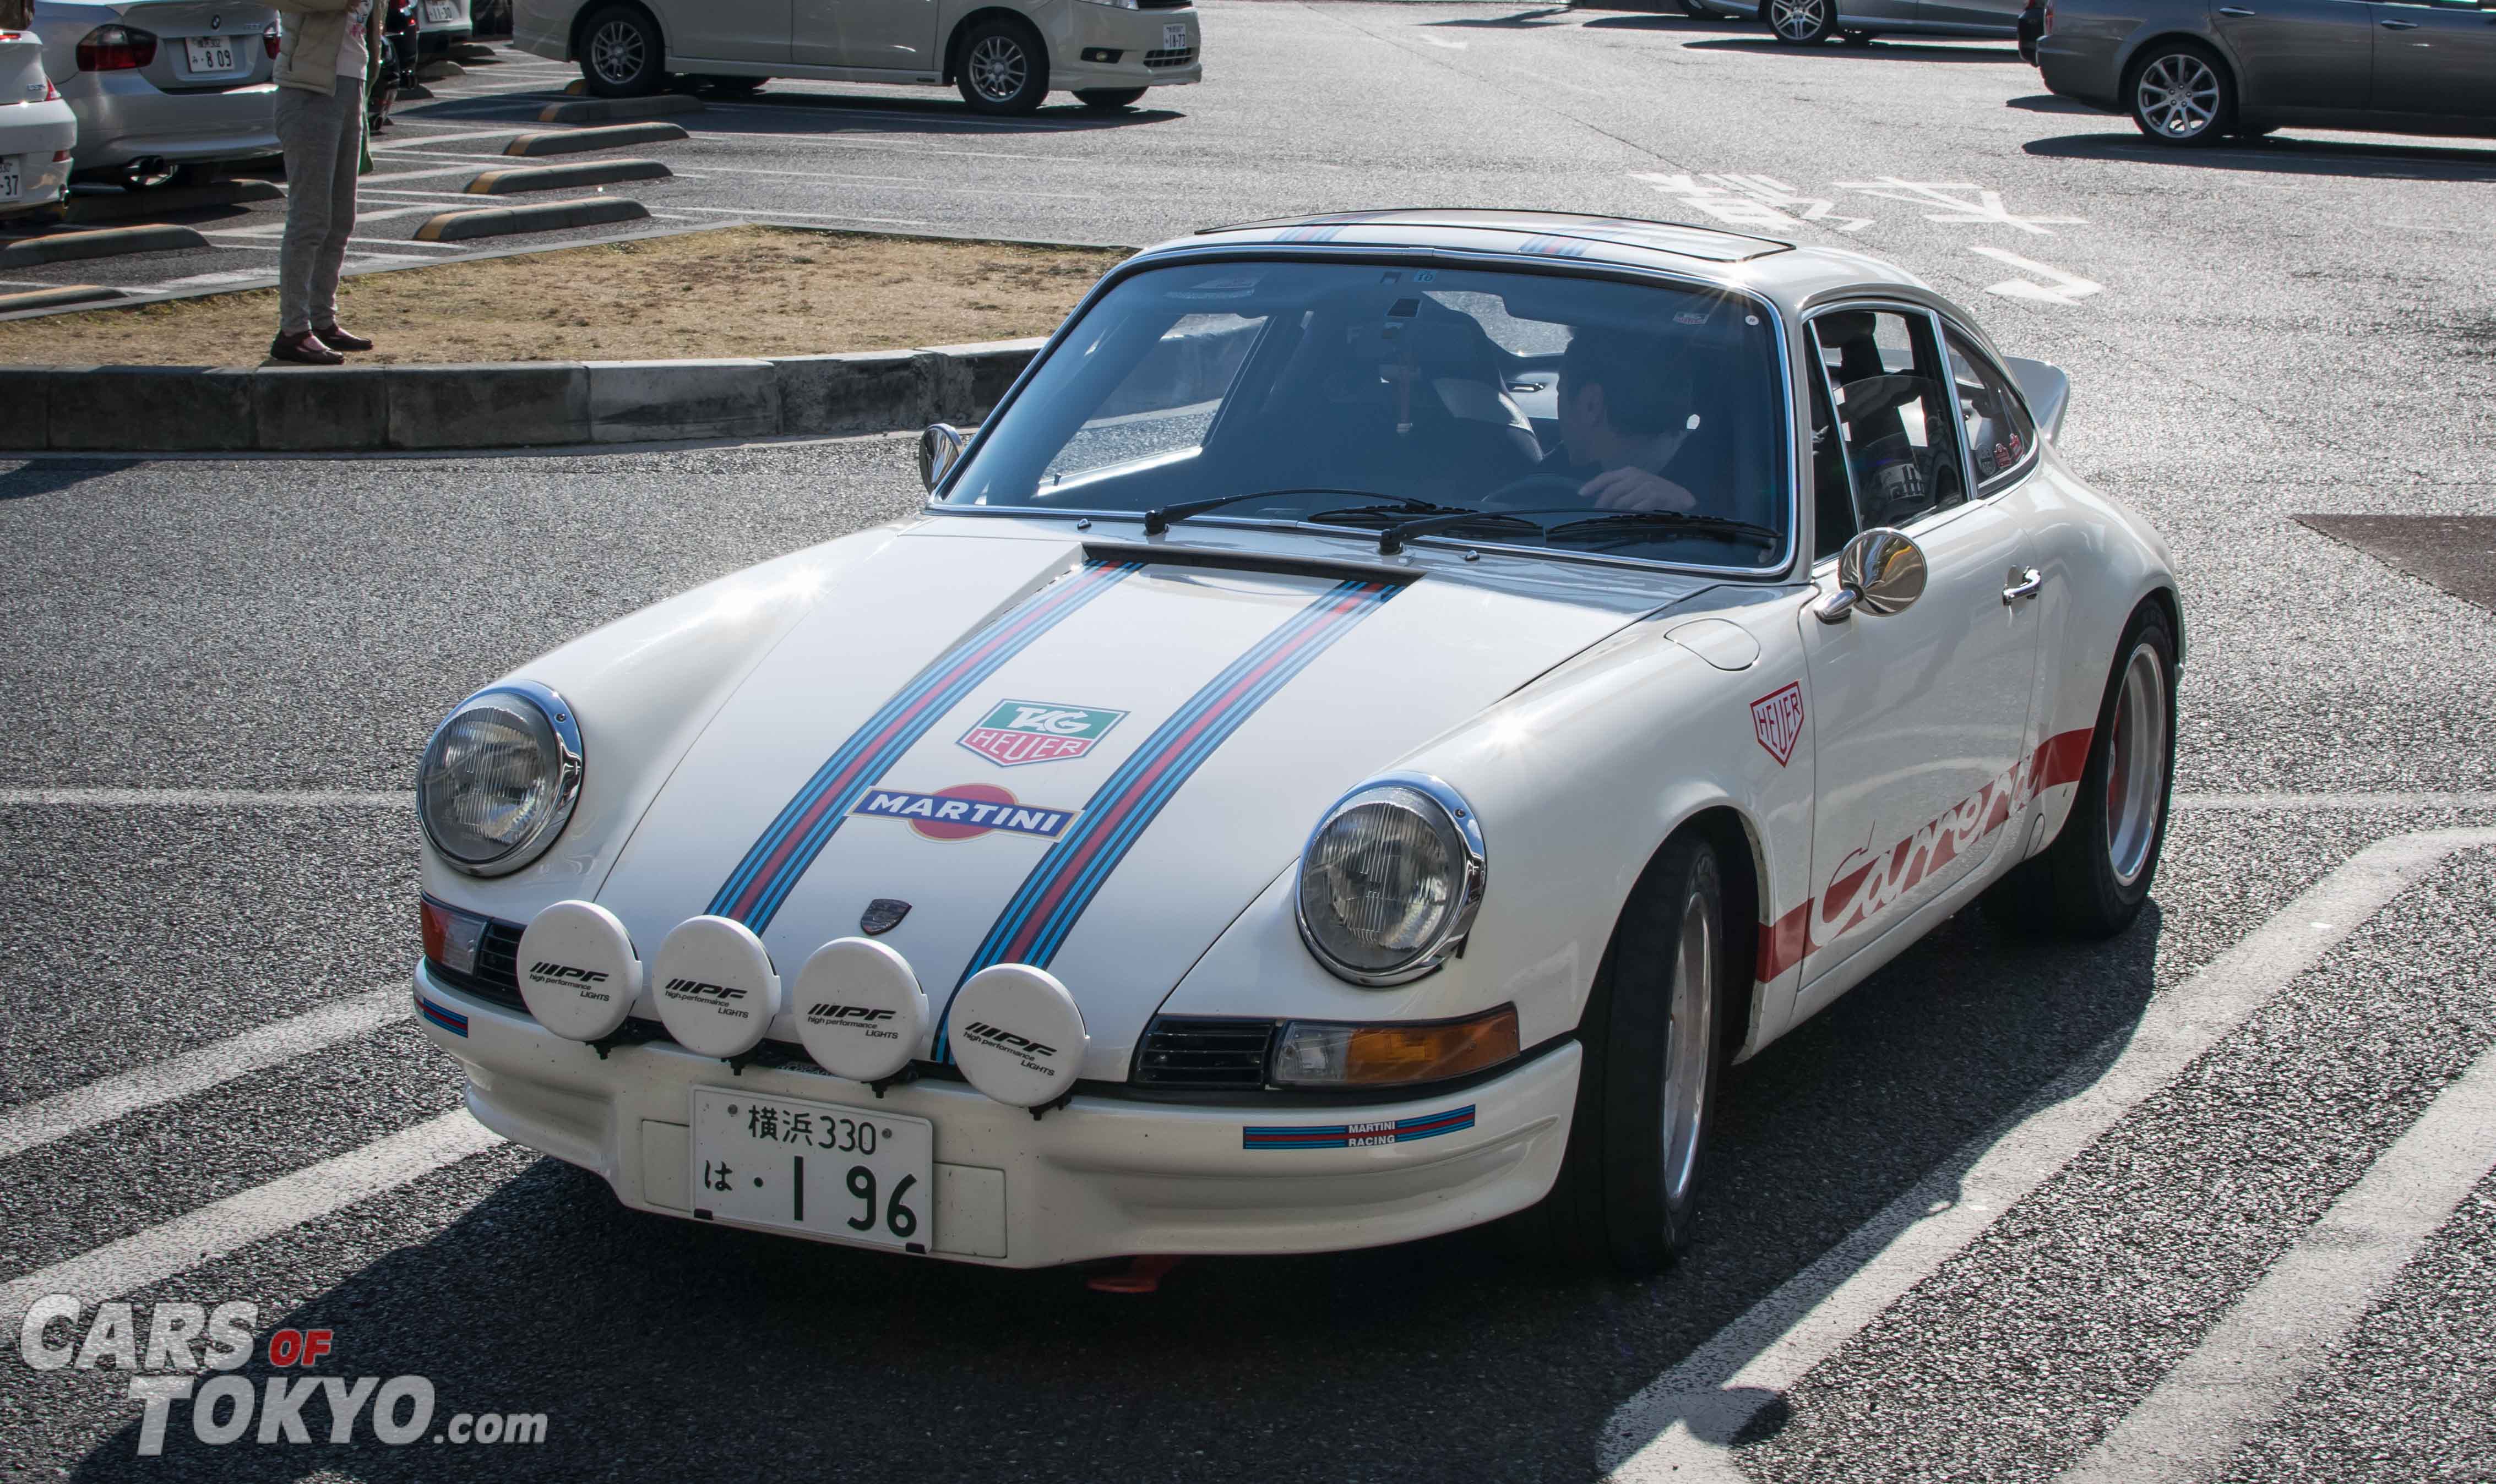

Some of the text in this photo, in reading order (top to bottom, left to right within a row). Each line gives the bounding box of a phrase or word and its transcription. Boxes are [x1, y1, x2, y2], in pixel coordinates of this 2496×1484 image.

[1007, 706, 1091, 734] TAG
[1757, 692, 1801, 755] HEUER
[972, 731, 1083, 761] HEUER
[867, 793, 1062, 832] MARTINI
[1810, 749, 2040, 947] Carrera
[529, 973, 592, 990] high performance
[580, 990, 610, 1002] LIGHTS
[665, 990, 730, 1007] high performance
[717, 1007, 749, 1018] LIGHTS
[807, 1016, 877, 1029] high performance
[865, 1029, 899, 1039] LIGHTS
[963, 1031, 1035, 1061] high performance
[1020, 1060, 1056, 1076] LIGHTS
[748, 1105, 877, 1155] 横浜330
[1348, 1121, 1395, 1133] MARTINI
[1348, 1135, 1395, 1147] RACING
